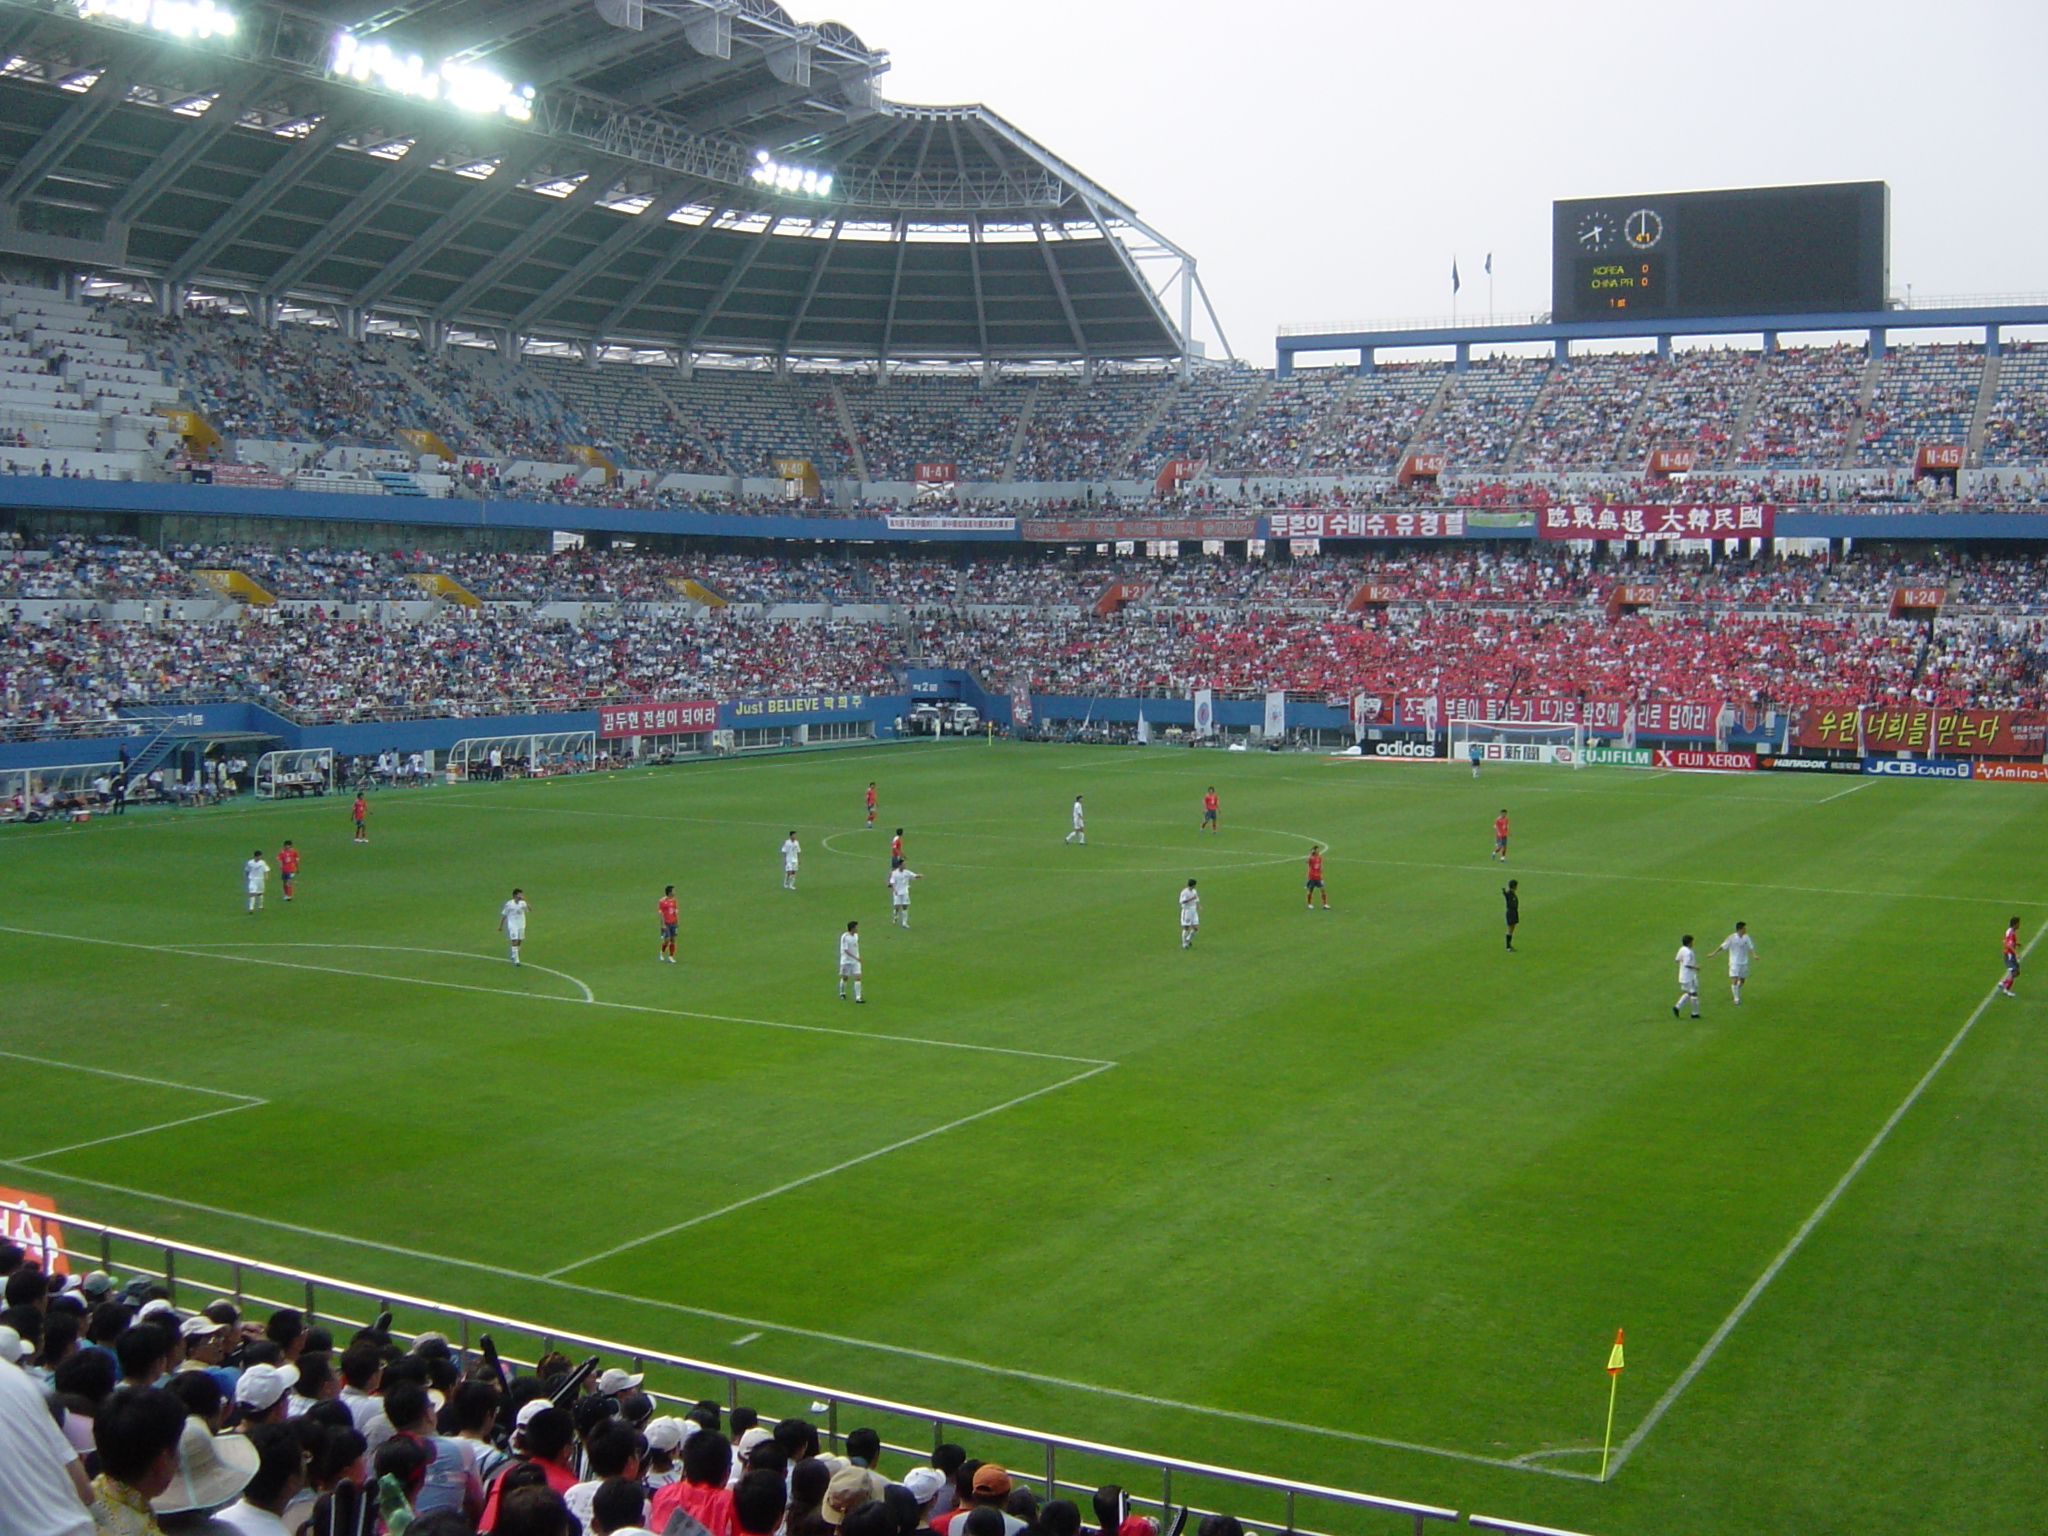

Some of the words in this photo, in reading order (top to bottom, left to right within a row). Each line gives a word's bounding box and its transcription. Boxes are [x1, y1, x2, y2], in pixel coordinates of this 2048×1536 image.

[1593, 266, 1624, 275] KOREA
[1660, 452, 1690, 467] N-44
[1926, 449, 1959, 464] N-45
[922, 465, 949, 478] N-41
[1271, 514, 1323, 536] 투혼의
[1330, 514, 1389, 536] 수비수,
[1546, 505, 1645, 533] 臨戰無退
[1657, 505, 1763, 533] 大韓民國
[1121, 585, 1146, 598] N-21
[1370, 586, 1391, 599] N-2
[1625, 588, 1655, 602] N-23
[1904, 590, 1936, 605] N-24
[736, 701, 763, 715] Just
[768, 698, 819, 713] BELIEVE
[603, 711, 639, 731] 김두현
[643, 708, 678, 729] 전설이
[682, 706, 717, 725] 되어라
[1445, 698, 1479, 720] 부름이
[1540, 699, 1576, 722] 뜨거운
[1669, 703, 1711, 731] 답하라!
[1818, 709, 1859, 742] 우린
[1867, 711, 1928, 745] 너희를
[1937, 714, 2000, 748] 믿는다
[1375, 740, 1436, 757] adidas
[1578, 749, 1649, 764] FUJIFILM
[1678, 752, 1703, 766] FUJI
[1707, 753, 1752, 768] XEROX
[1867, 761, 1917, 775] JCB
[1917, 765, 1956, 776] CARD
